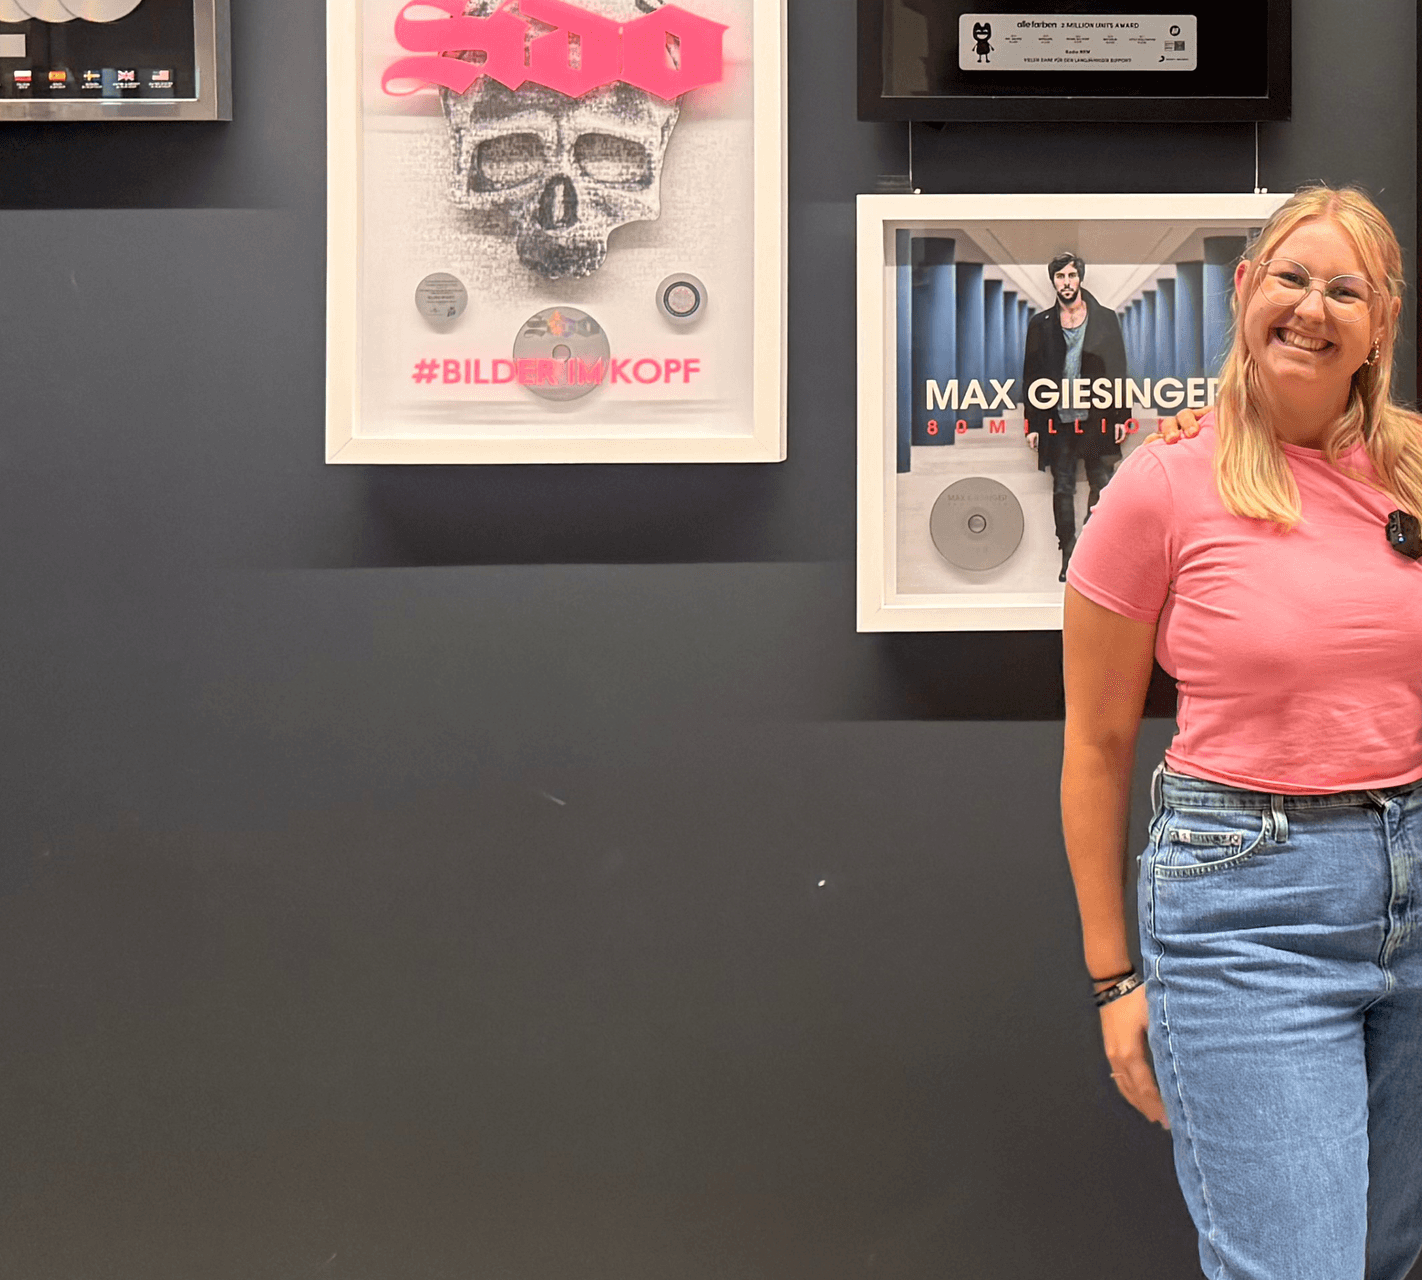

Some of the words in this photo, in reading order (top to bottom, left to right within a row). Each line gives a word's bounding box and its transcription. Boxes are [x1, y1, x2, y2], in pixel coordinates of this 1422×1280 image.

[411, 358, 558, 385] #BILDER
[567, 357, 603, 385] IM
[610, 358, 702, 384] KOPF
[925, 379, 1016, 411] MAX
[926, 419, 968, 435] 80
[989, 418, 1164, 435] MILLIO
